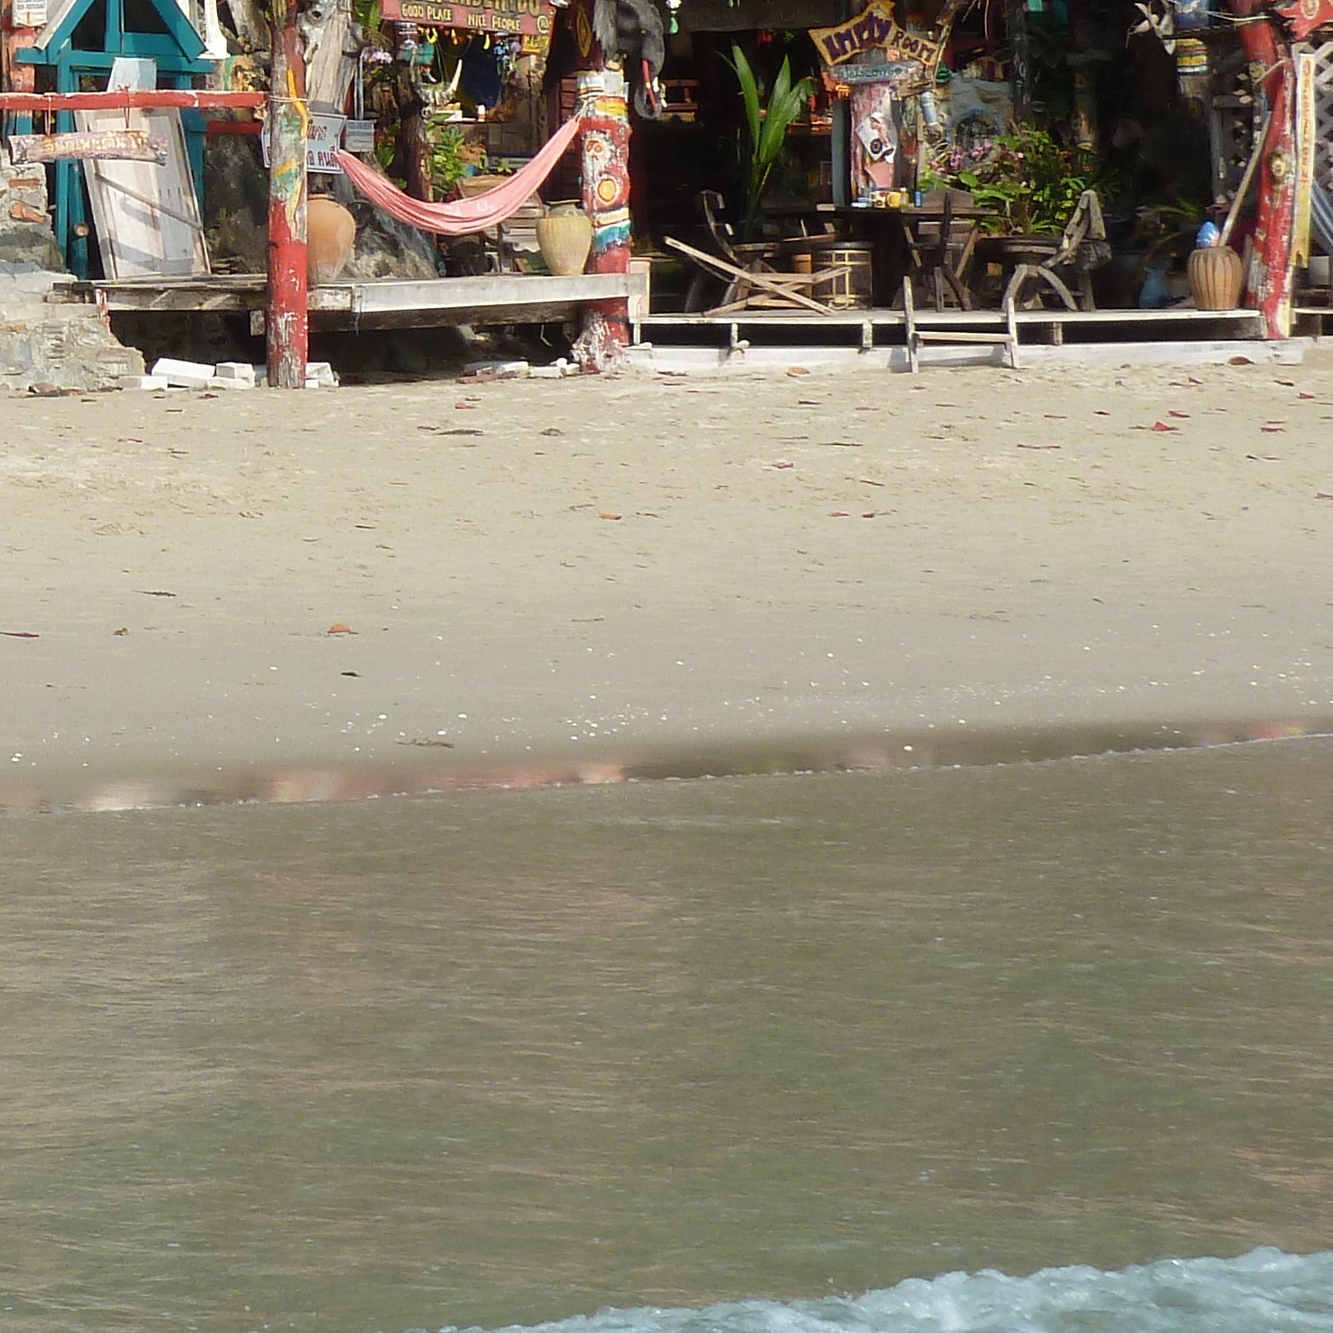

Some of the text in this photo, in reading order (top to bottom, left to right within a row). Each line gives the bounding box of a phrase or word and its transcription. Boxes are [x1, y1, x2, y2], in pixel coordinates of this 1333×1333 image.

[401, 4, 522, 32] GOOD PLACE NICE PEOPLE
[894, 31, 937, 63] ROOM
